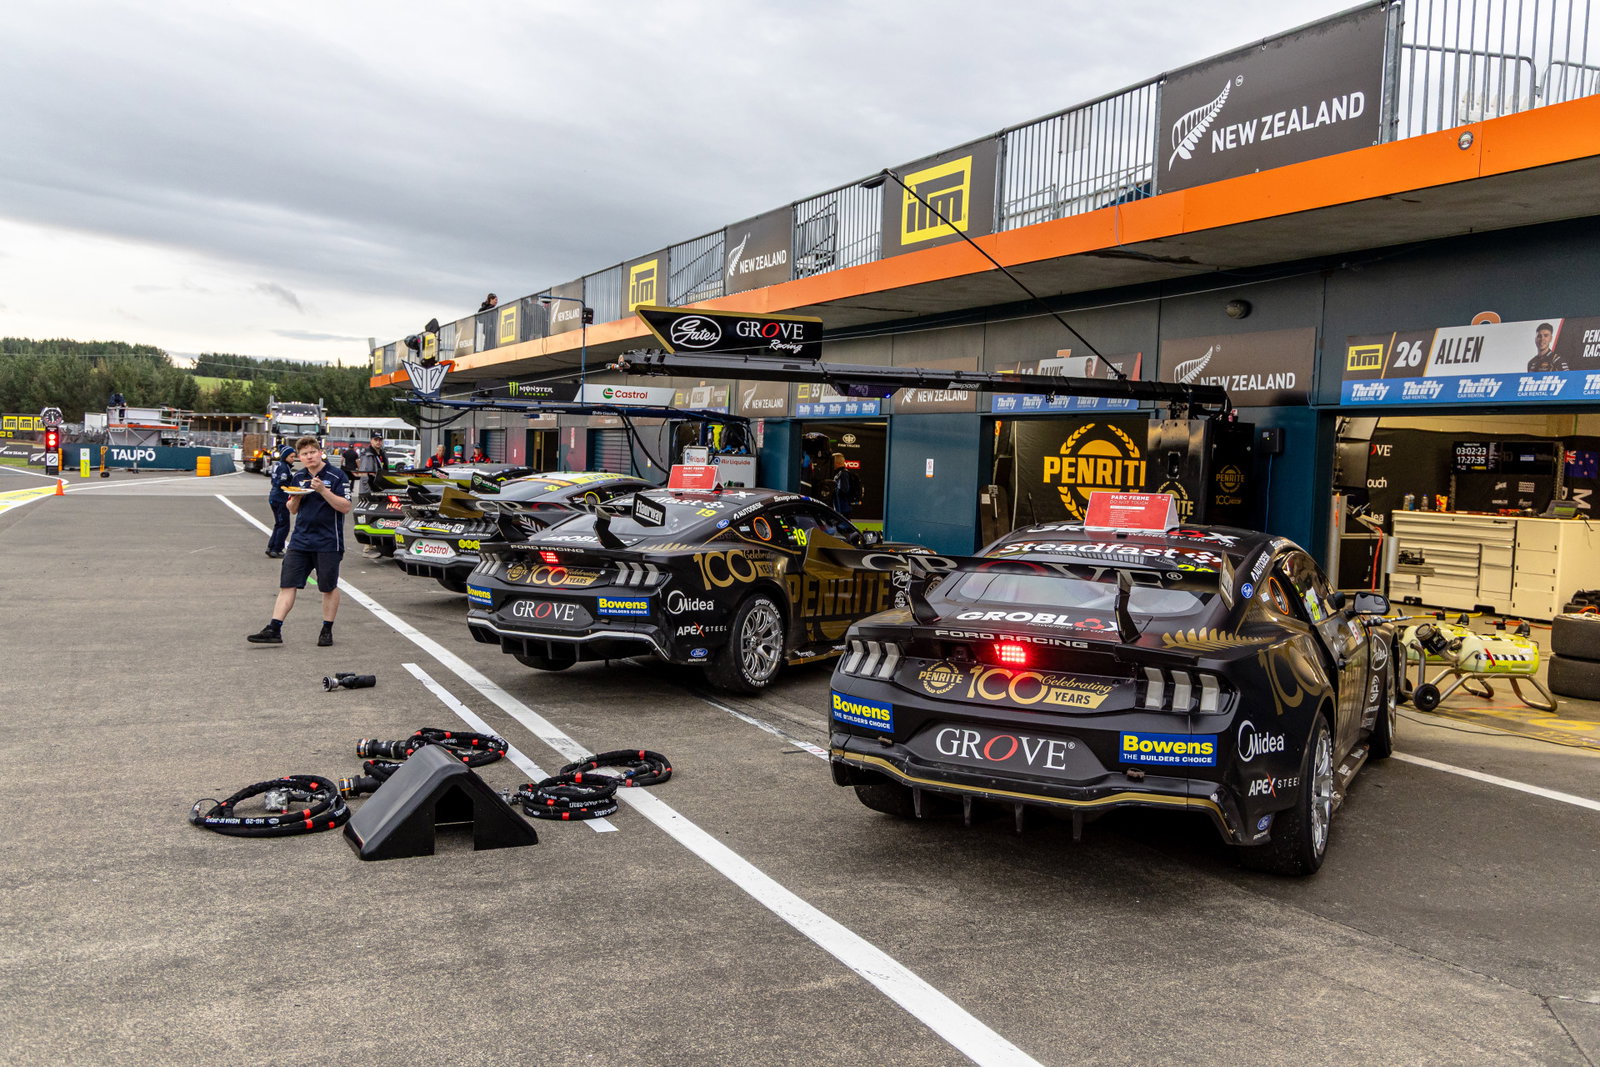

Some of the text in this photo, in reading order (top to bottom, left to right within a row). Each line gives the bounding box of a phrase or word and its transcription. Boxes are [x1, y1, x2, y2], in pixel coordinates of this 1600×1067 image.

[1211, 91, 1365, 154] NEW ZEALAND
[739, 249, 787, 275] NEW ZEALAND
[673, 320, 718, 344] Gates
[736, 320, 804, 340] GROVE
[768, 340, 803, 354] Racing
[1393, 340, 1423, 368] 26
[1434, 336, 1484, 365] ALLEN
[1231, 372, 1296, 391] ZEALAND
[1352, 382, 1390, 401] Thrifty
[1403, 380, 1444, 399] Thrifty
[1457, 378, 1503, 398] Thrifty
[1518, 375, 1568, 396] Thrifty
[614, 389, 648, 400] Castrol
[917, 390, 968, 403] NEW ZEALAND
[111, 448, 156, 462] TAUPŌ
[1456, 447, 1487, 456] 03:02:23
[1457, 455, 1486, 464] 17:27:35
[1215, 473, 1246, 483] PENRITE
[635, 499, 664, 521] Floorway
[695, 508, 717, 518] 19
[737, 502, 764, 518] AUTODESK
[793, 528, 808, 547] 19
[423, 543, 449, 555] Castrol
[540, 545, 585, 554] RACING
[1000, 541, 1177, 560] steadfast
[466, 585, 491, 600] Bowens
[512, 600, 576, 622] GROVE
[598, 598, 648, 610] Bowens
[669, 594, 714, 612] Midea
[676, 623, 704, 637] APEX
[934, 630, 1089, 649] FORD RACING
[918, 671, 964, 684] PENRITE
[1042, 674, 1113, 695] Celebrating
[1054, 691, 1091, 705] YEARS
[833, 694, 891, 721] Bowens
[868, 720, 891, 730] CHOICE
[935, 728, 1067, 770] GROVE
[1123, 735, 1214, 755] Bowens
[1243, 728, 1285, 759] Midea
[1140, 754, 1180, 763] BUILDERS
[1248, 775, 1277, 797] APEX
